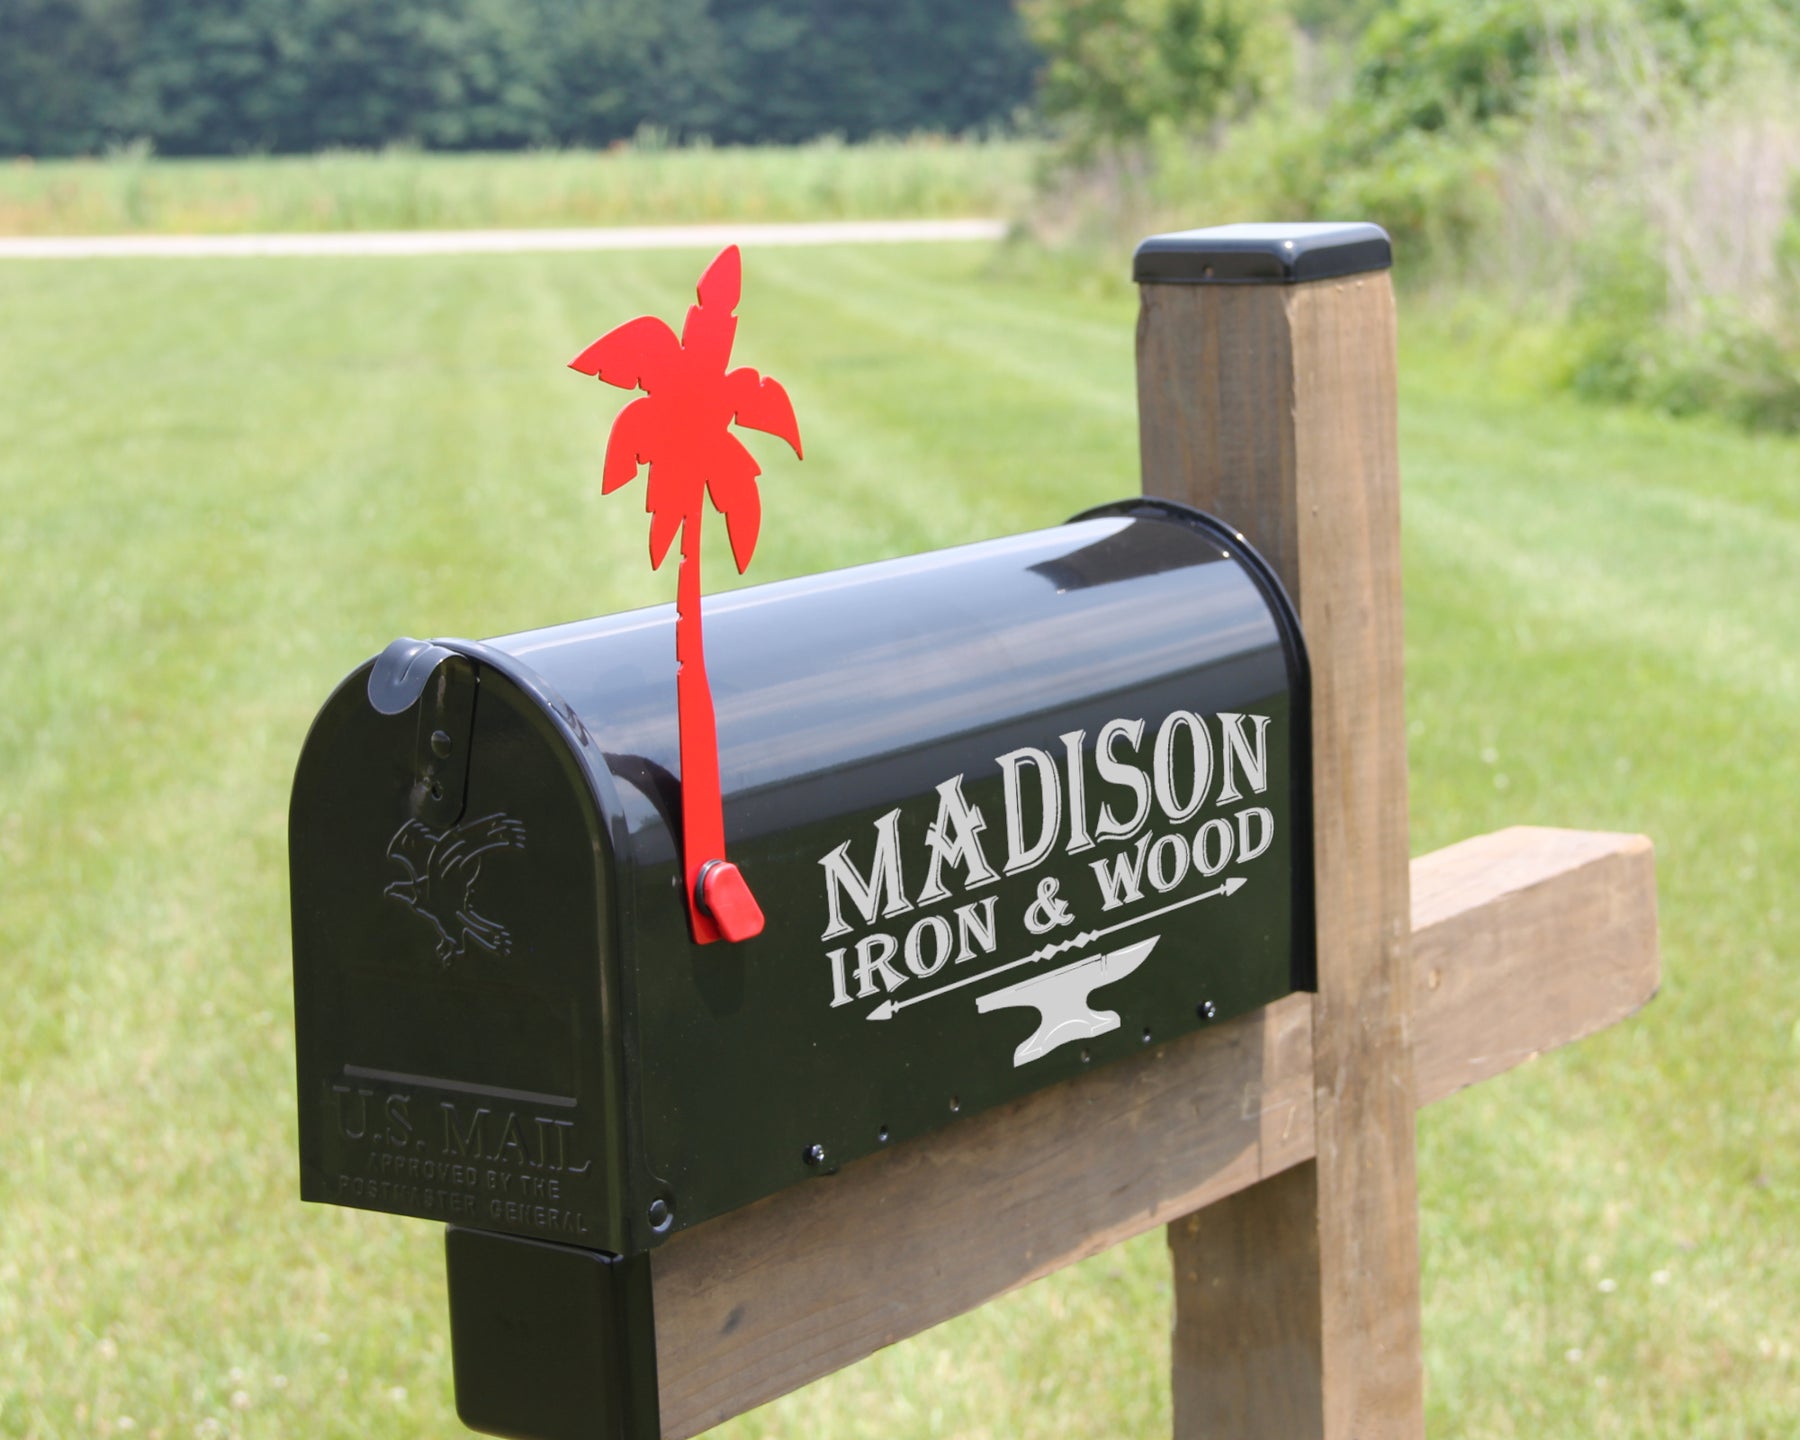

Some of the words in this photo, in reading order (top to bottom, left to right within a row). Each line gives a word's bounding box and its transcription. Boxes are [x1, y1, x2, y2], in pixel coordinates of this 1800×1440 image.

[817, 710, 1271, 941] MADISON
[825, 896, 999, 1008] IRON
[1023, 876, 1076, 934] &
[1088, 807, 1275, 911] WOOD
[331, 1084, 427, 1150] U.S.
[439, 1102, 592, 1173] MAIL
[338, 1174, 476, 1214] POSTMASTER
[490, 1199, 589, 1233] GENERAL
[367, 1152, 477, 1186] APPROVED
[487, 1169, 512, 1191] BY
[520, 1175, 561, 1200] THE
